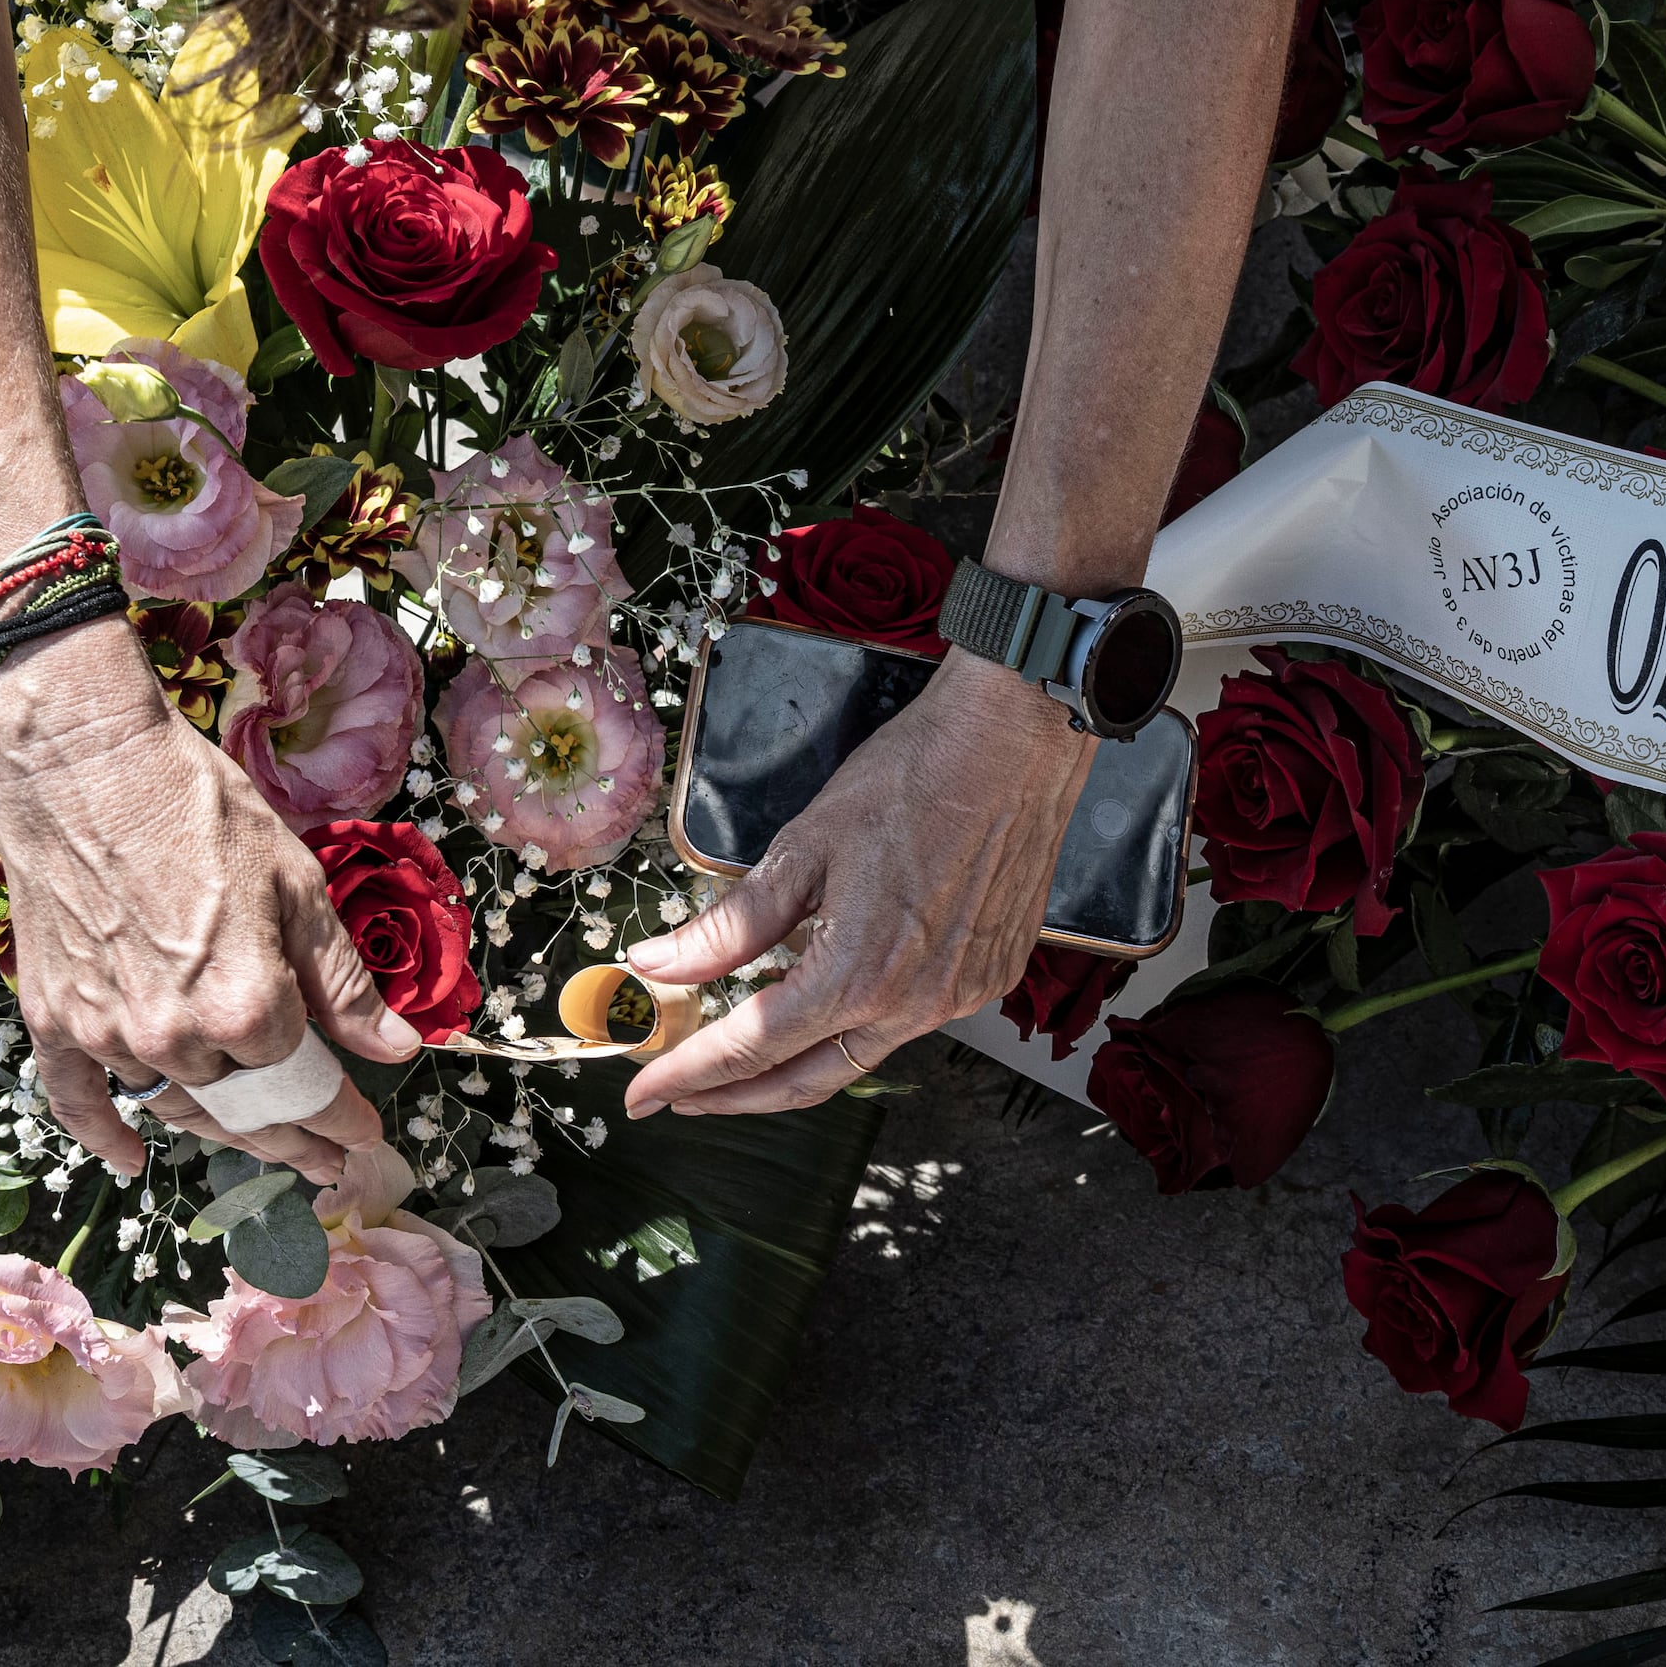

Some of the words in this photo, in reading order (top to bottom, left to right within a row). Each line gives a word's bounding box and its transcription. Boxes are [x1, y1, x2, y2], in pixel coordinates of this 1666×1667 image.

[1430, 482, 1526, 529] Asociación
[1529, 501, 1551, 524] de
[1428, 536, 1447, 581] Julio
[1461, 547, 1542, 593] AV3J
[1550, 525, 1578, 614] víctimas
[1442, 587, 1458, 612] de
[1456, 616, 1468, 631] 3
[1540, 618, 1565, 651] del
[1468, 629, 1492, 654] del
[1497, 641, 1542, 665] metro
